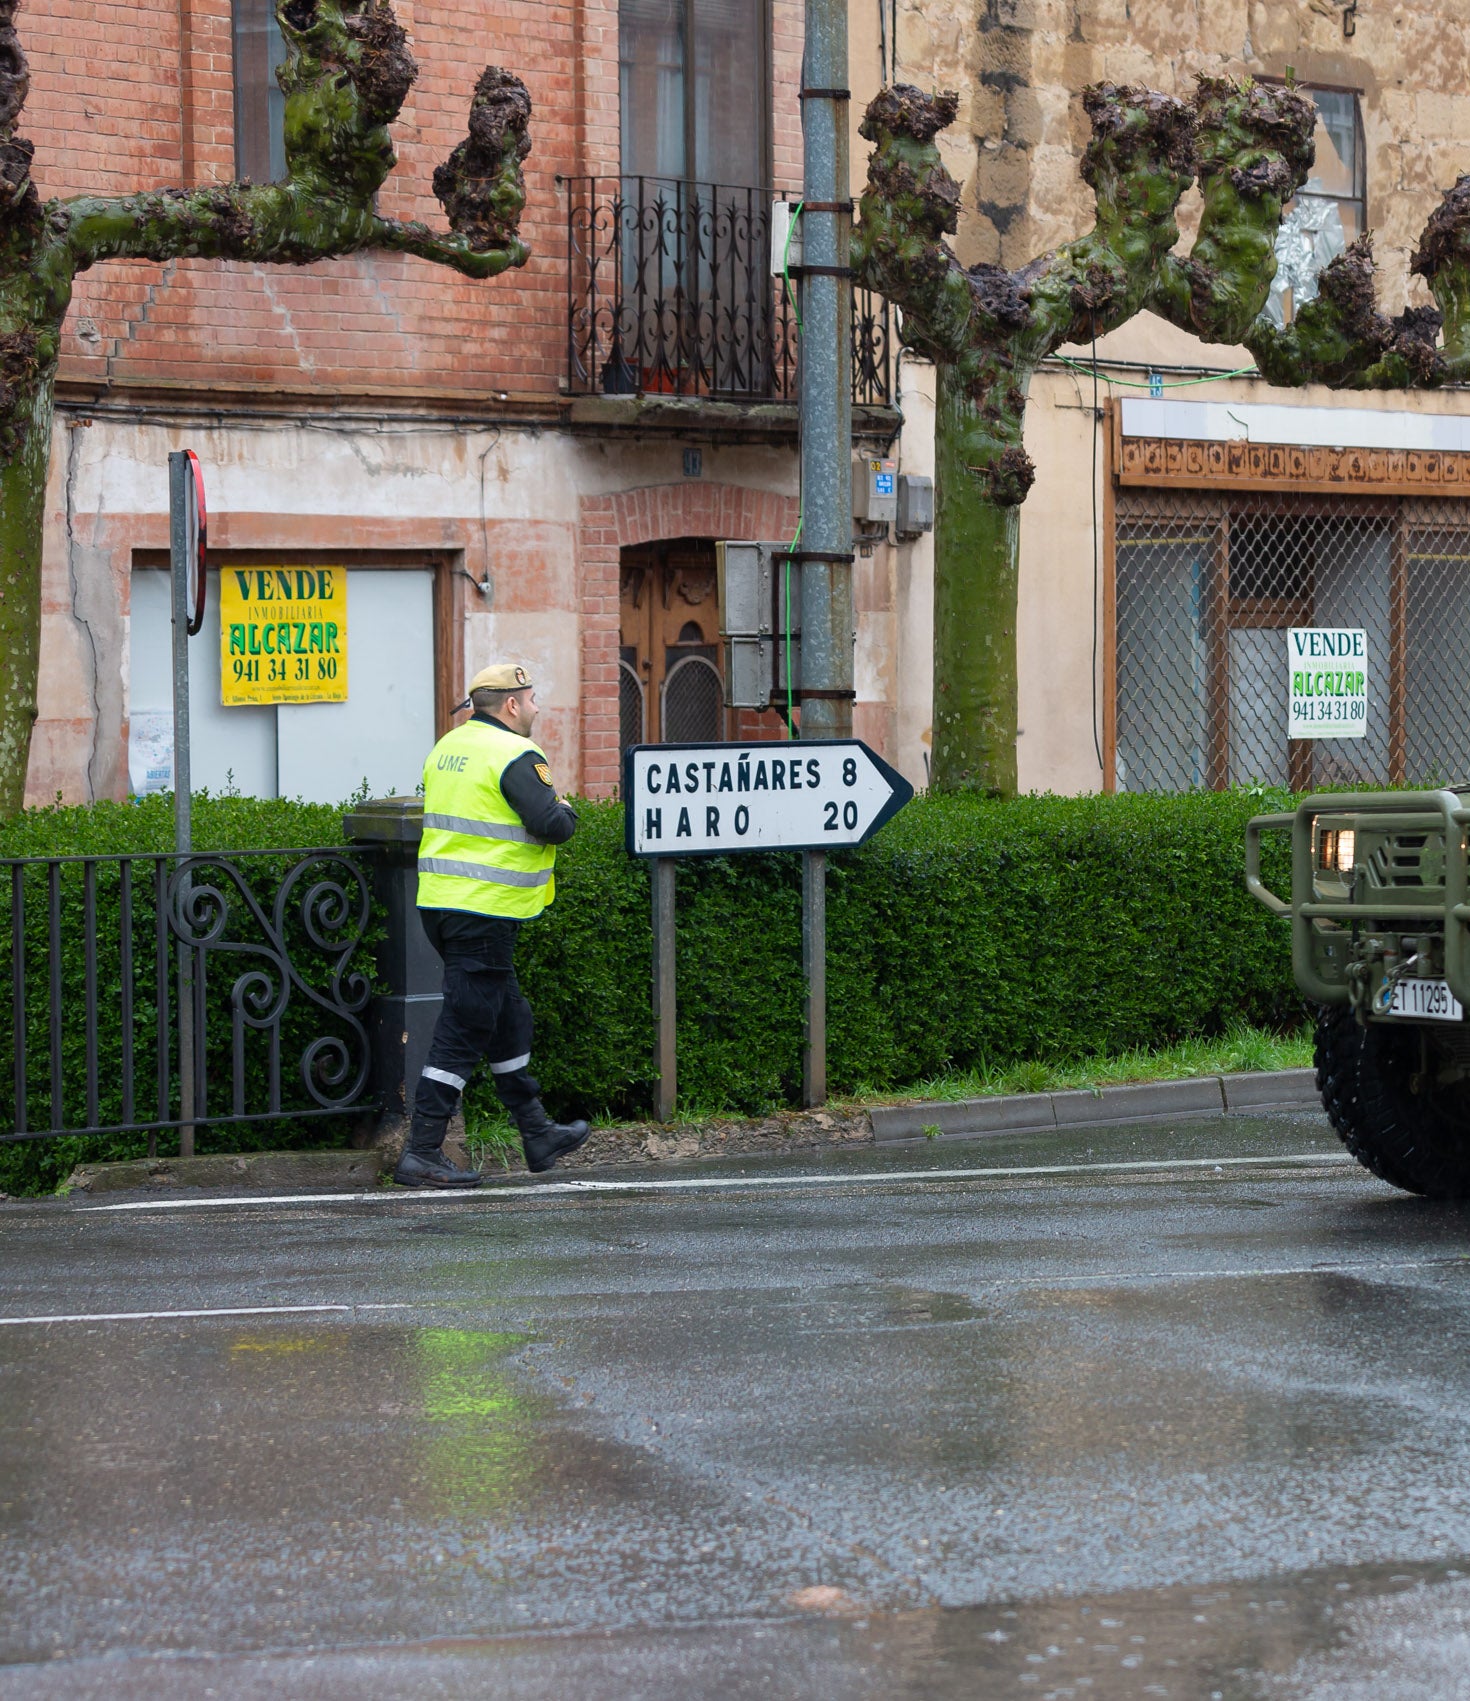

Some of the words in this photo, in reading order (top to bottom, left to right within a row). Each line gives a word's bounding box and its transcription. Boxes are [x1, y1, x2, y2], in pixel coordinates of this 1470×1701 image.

[234, 569, 334, 600] VENDE
[248, 606, 323, 620] INMOBILIARIA
[229, 622, 340, 655] ALCAZAR
[1293, 632, 1364, 657] VENDE
[233, 659, 259, 683] 941
[267, 658, 286, 681] 34
[294, 658, 309, 680] 31
[318, 656, 337, 680] 80
[1293, 671, 1365, 697] ALCAZAR
[437, 754, 468, 773] UME
[647, 752, 821, 794] CASTAÑARES
[842, 758, 857, 787] 8
[646, 804, 750, 840] HARO
[824, 800, 858, 830] 20
